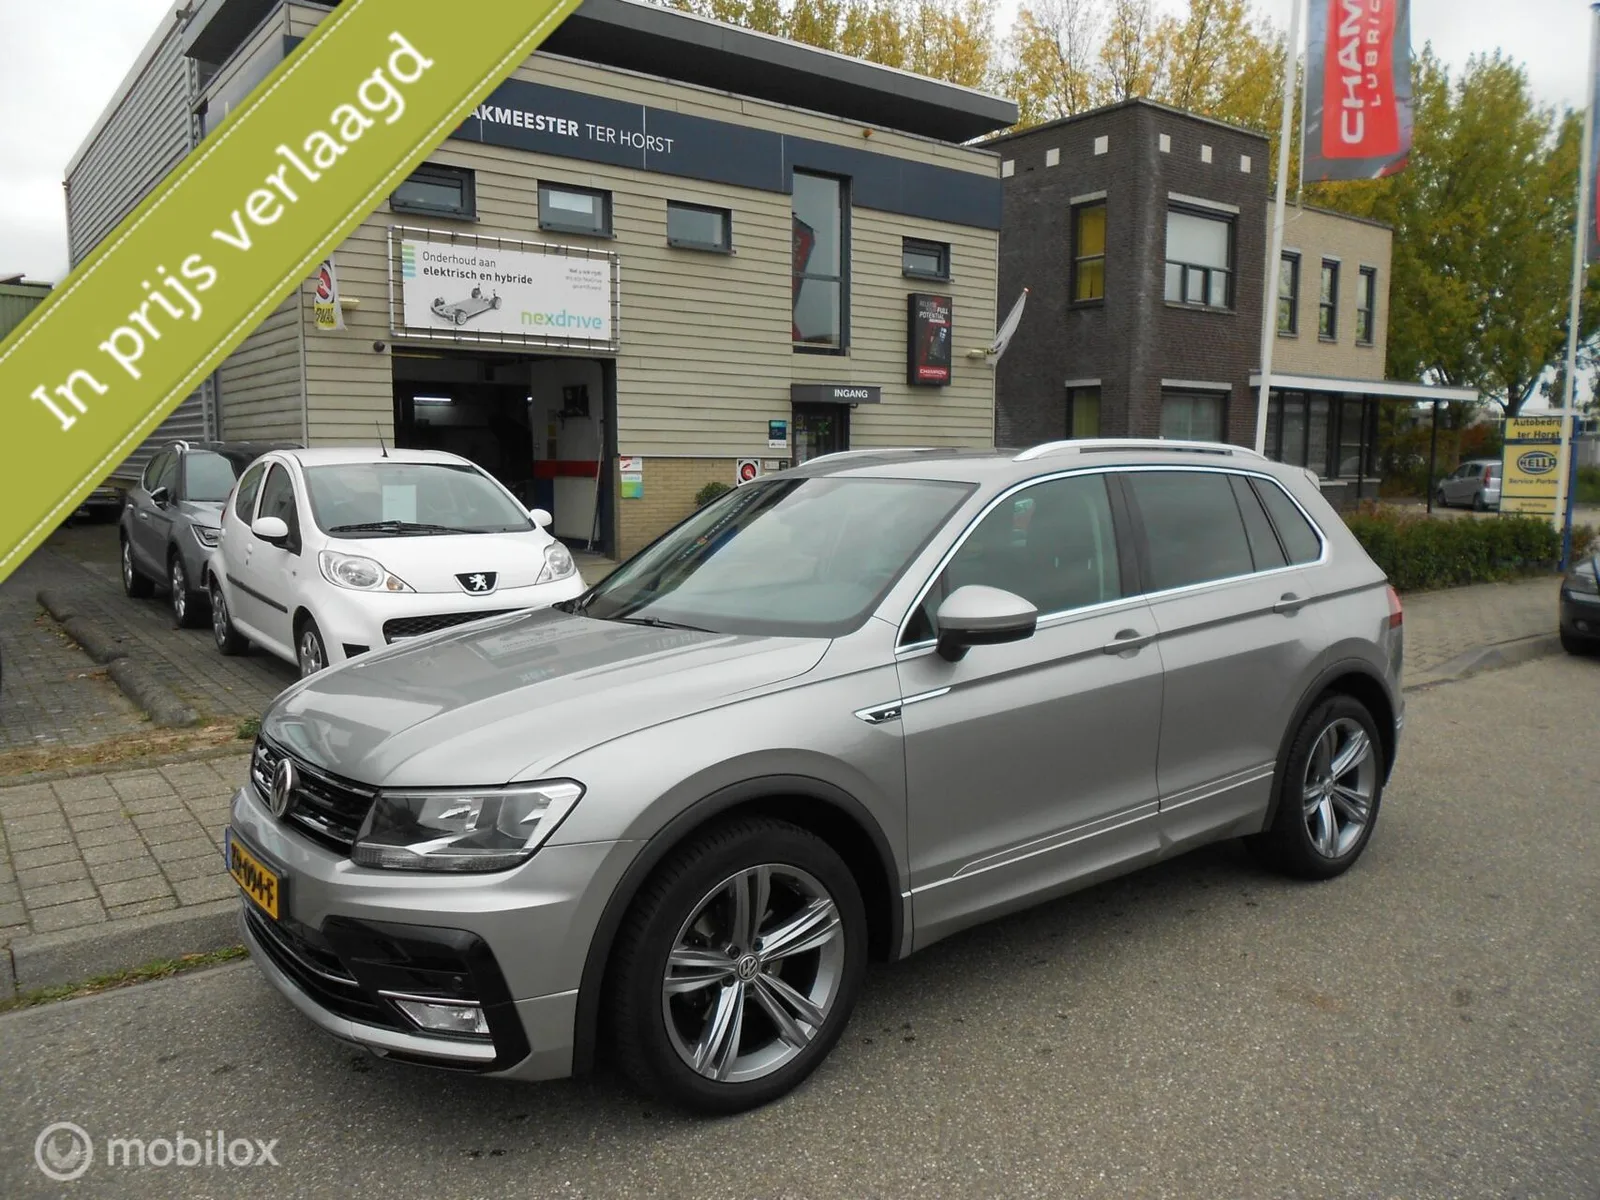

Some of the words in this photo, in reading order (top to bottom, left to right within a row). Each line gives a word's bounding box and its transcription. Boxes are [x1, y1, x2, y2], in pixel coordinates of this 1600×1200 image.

[469, 100, 579, 137] AKMEESTER
[585, 123, 616, 144] TER
[620, 130, 675, 154] HORST
[422, 251, 477, 266] Onderhoud
[478, 258, 497, 268] aan
[423, 266, 477, 280] elektrisch
[479, 272, 493, 281] en
[494, 272, 534, 285] hybride
[520, 309, 603, 329] nexdrive
[834, 388, 869, 399] INGANG
[1512, 417, 1562, 428] Autobedrij
[1519, 457, 1558, 469] HELLA
